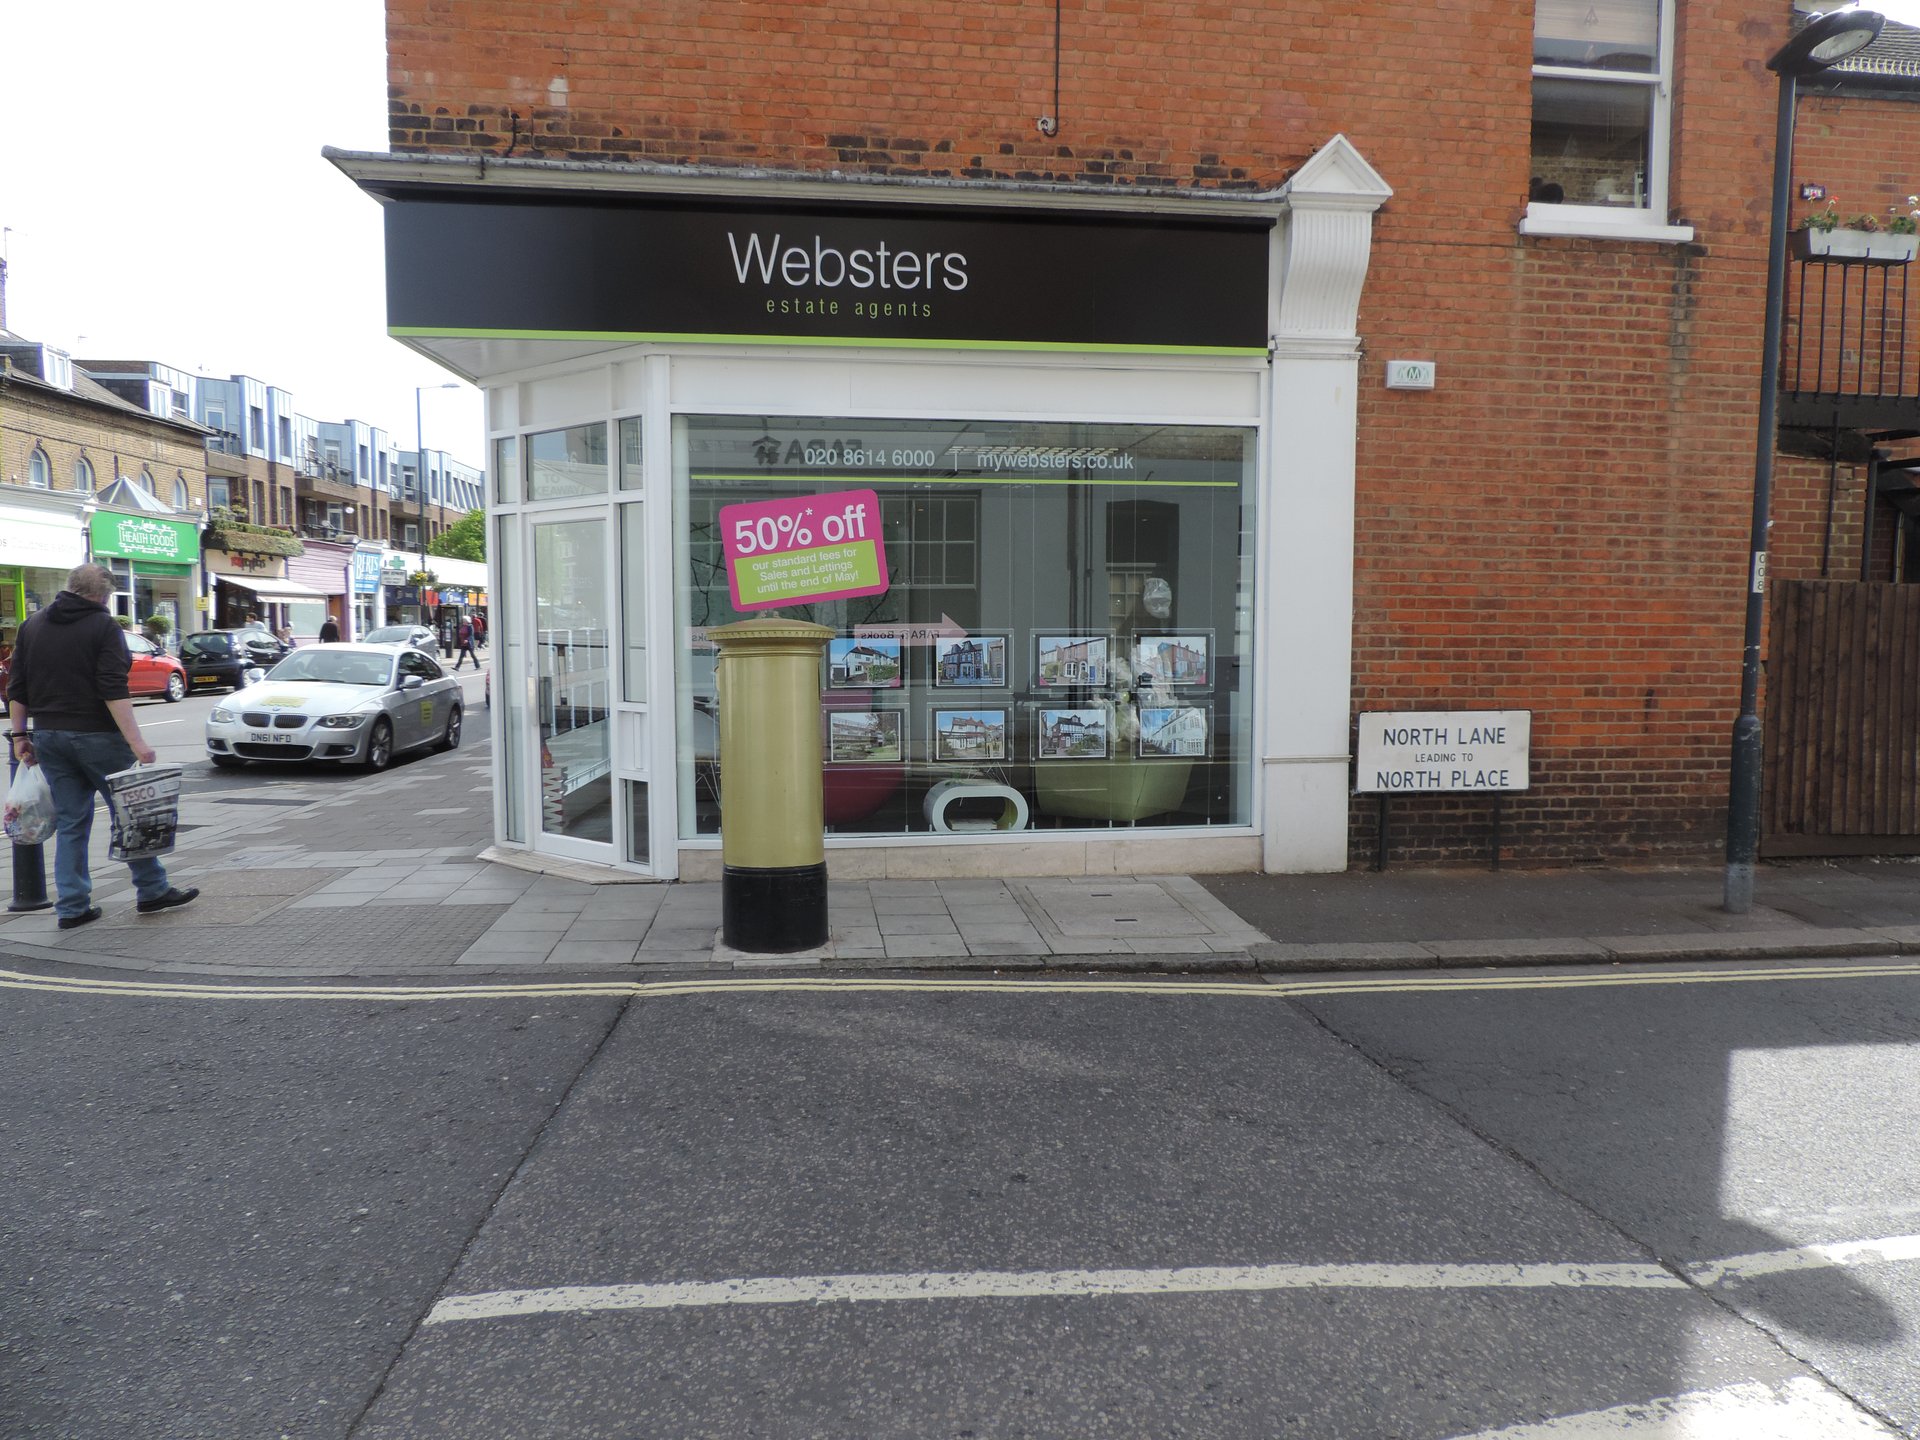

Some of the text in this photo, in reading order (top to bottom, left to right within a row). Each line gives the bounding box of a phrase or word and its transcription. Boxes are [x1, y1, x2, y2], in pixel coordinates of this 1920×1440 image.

[727, 232, 968, 291] Websters
[766, 298, 931, 319] estate agents
[804, 448, 935, 467] 020 8614 6000
[977, 451, 1134, 472] mywebsters.co.uk
[822, 503, 866, 542] off
[121, 531, 176, 547] HEALTH FOODS
[752, 548, 857, 571] our standard fees for
[760, 560, 853, 582] Sales and Lettings
[757, 582, 779, 594] until
[781, 579, 797, 590] the
[800, 576, 820, 588] end
[823, 574, 832, 584] of
[835, 570, 859, 583] May!
[251, 733, 270, 742] DN61
[1383, 727, 1506, 746] NORTH LANE
[1415, 753, 1474, 763] LEADING TO
[1376, 770, 1509, 788] NORTH PLACE
[121, 786, 155, 804] TESCO
